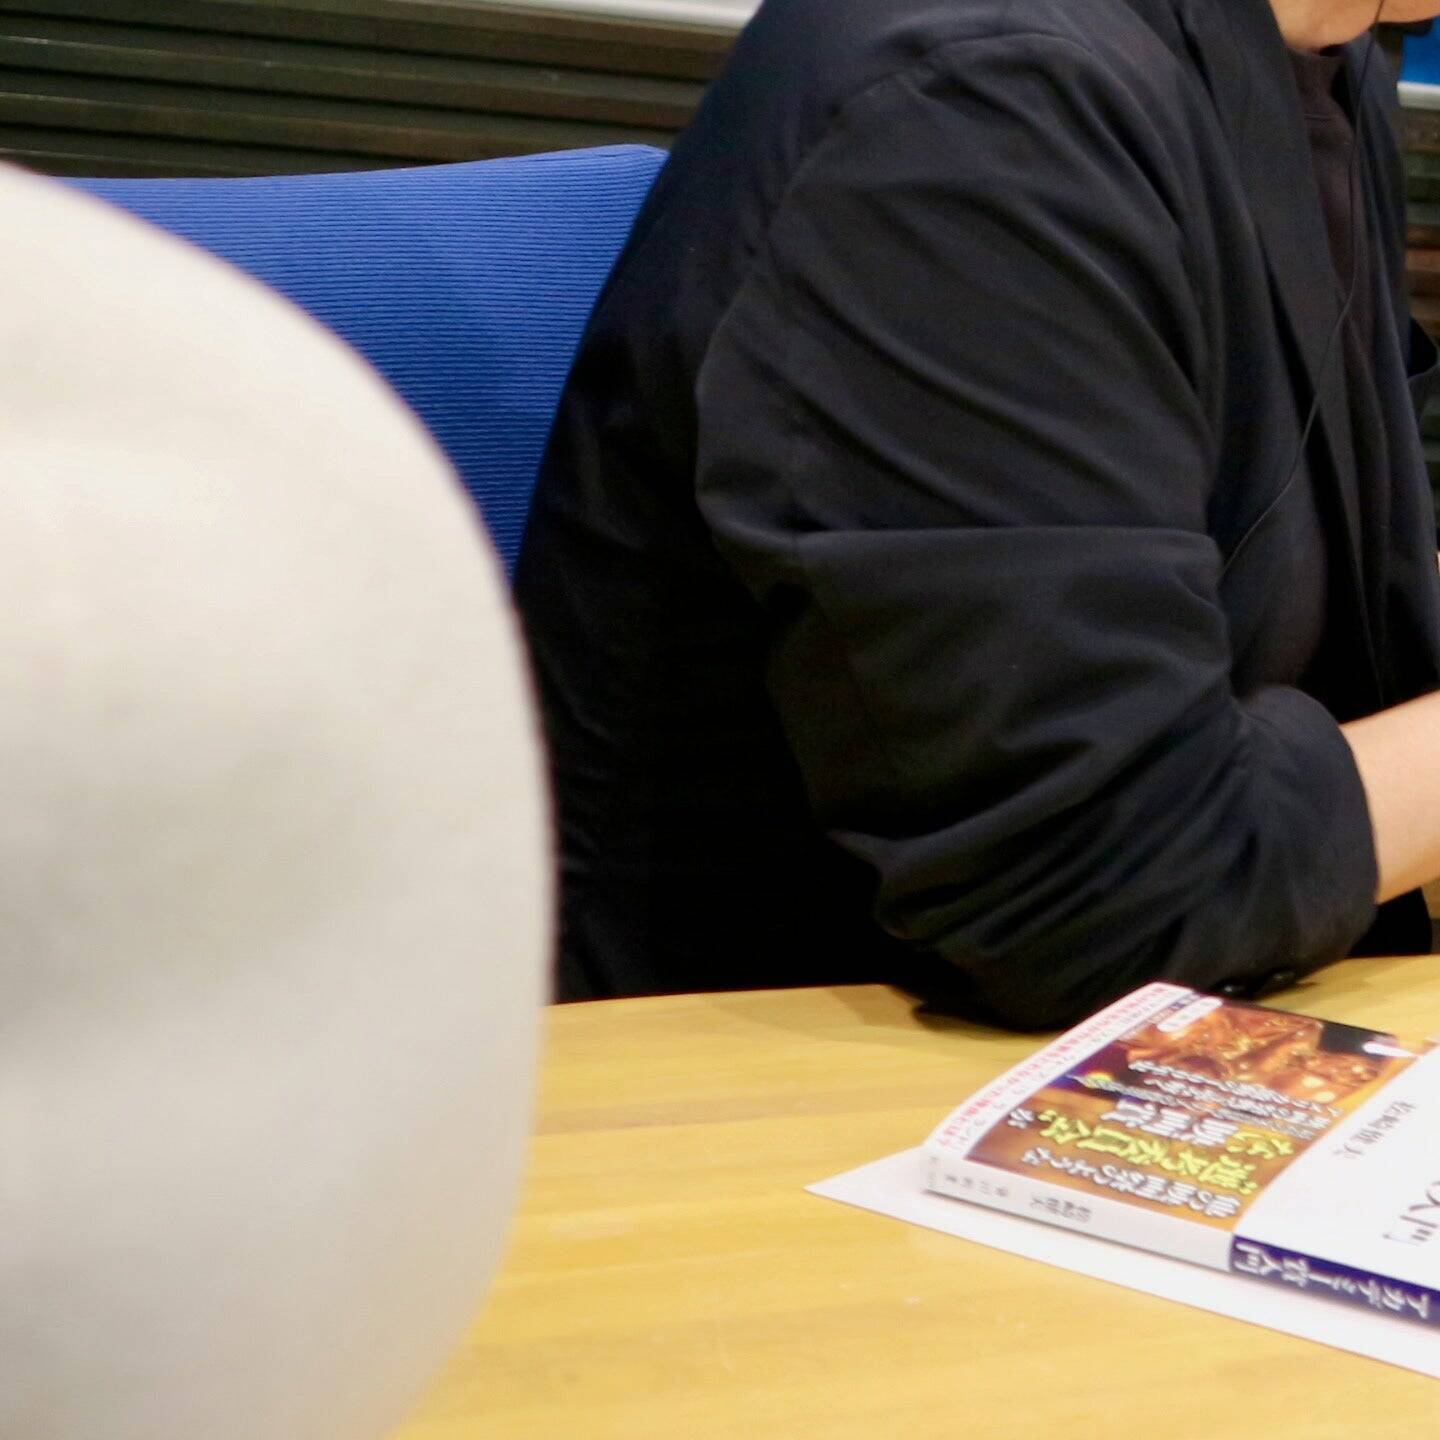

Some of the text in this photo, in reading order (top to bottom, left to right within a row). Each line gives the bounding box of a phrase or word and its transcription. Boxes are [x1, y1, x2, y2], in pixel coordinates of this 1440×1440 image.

[1234, 1239, 1430, 1323] アカデミー賞入門
